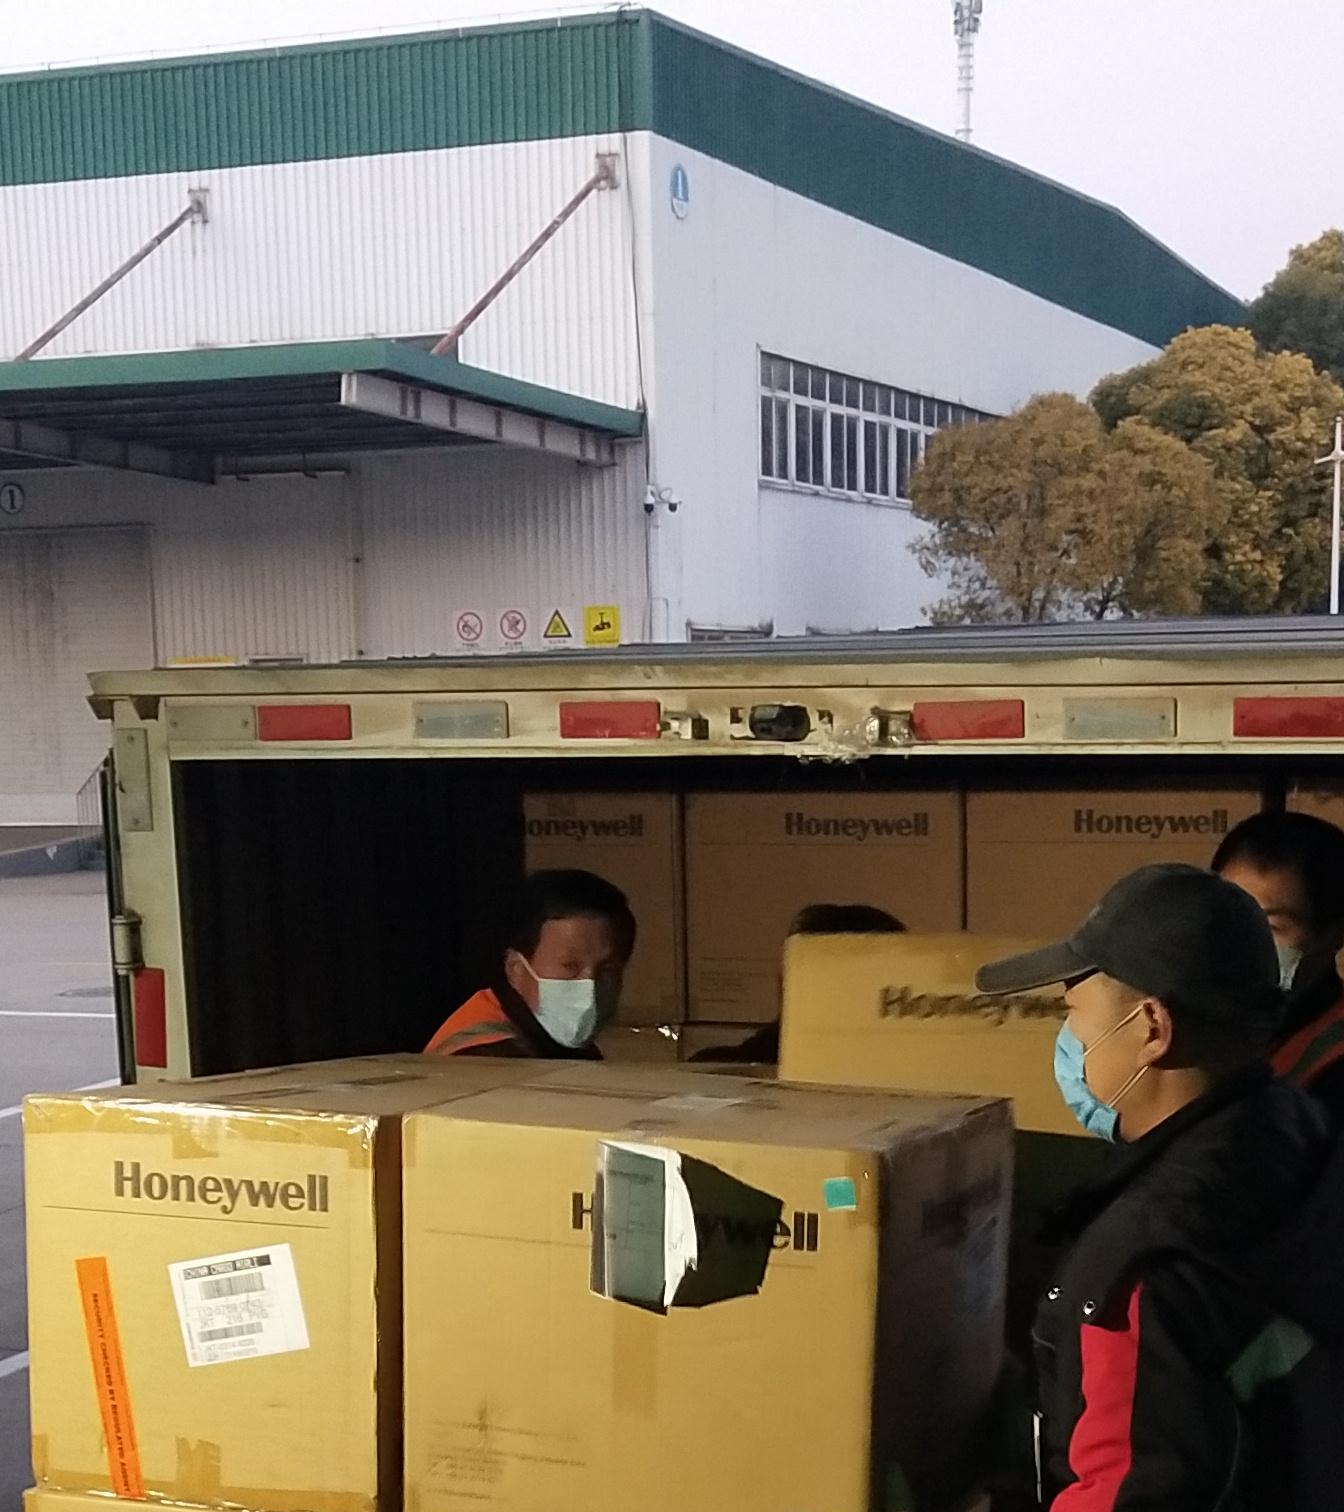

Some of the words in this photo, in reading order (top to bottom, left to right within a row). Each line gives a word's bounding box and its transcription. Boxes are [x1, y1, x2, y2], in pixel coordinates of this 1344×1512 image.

[527, 813, 644, 841] oneywell
[784, 812, 929, 842] Honeywell
[1073, 808, 1228, 839] Honeywell
[113, 1160, 330, 1215] Honeywell
[92, 1292, 106, 1339] SECURITY
[101, 1342, 113, 1387] CHECKED
